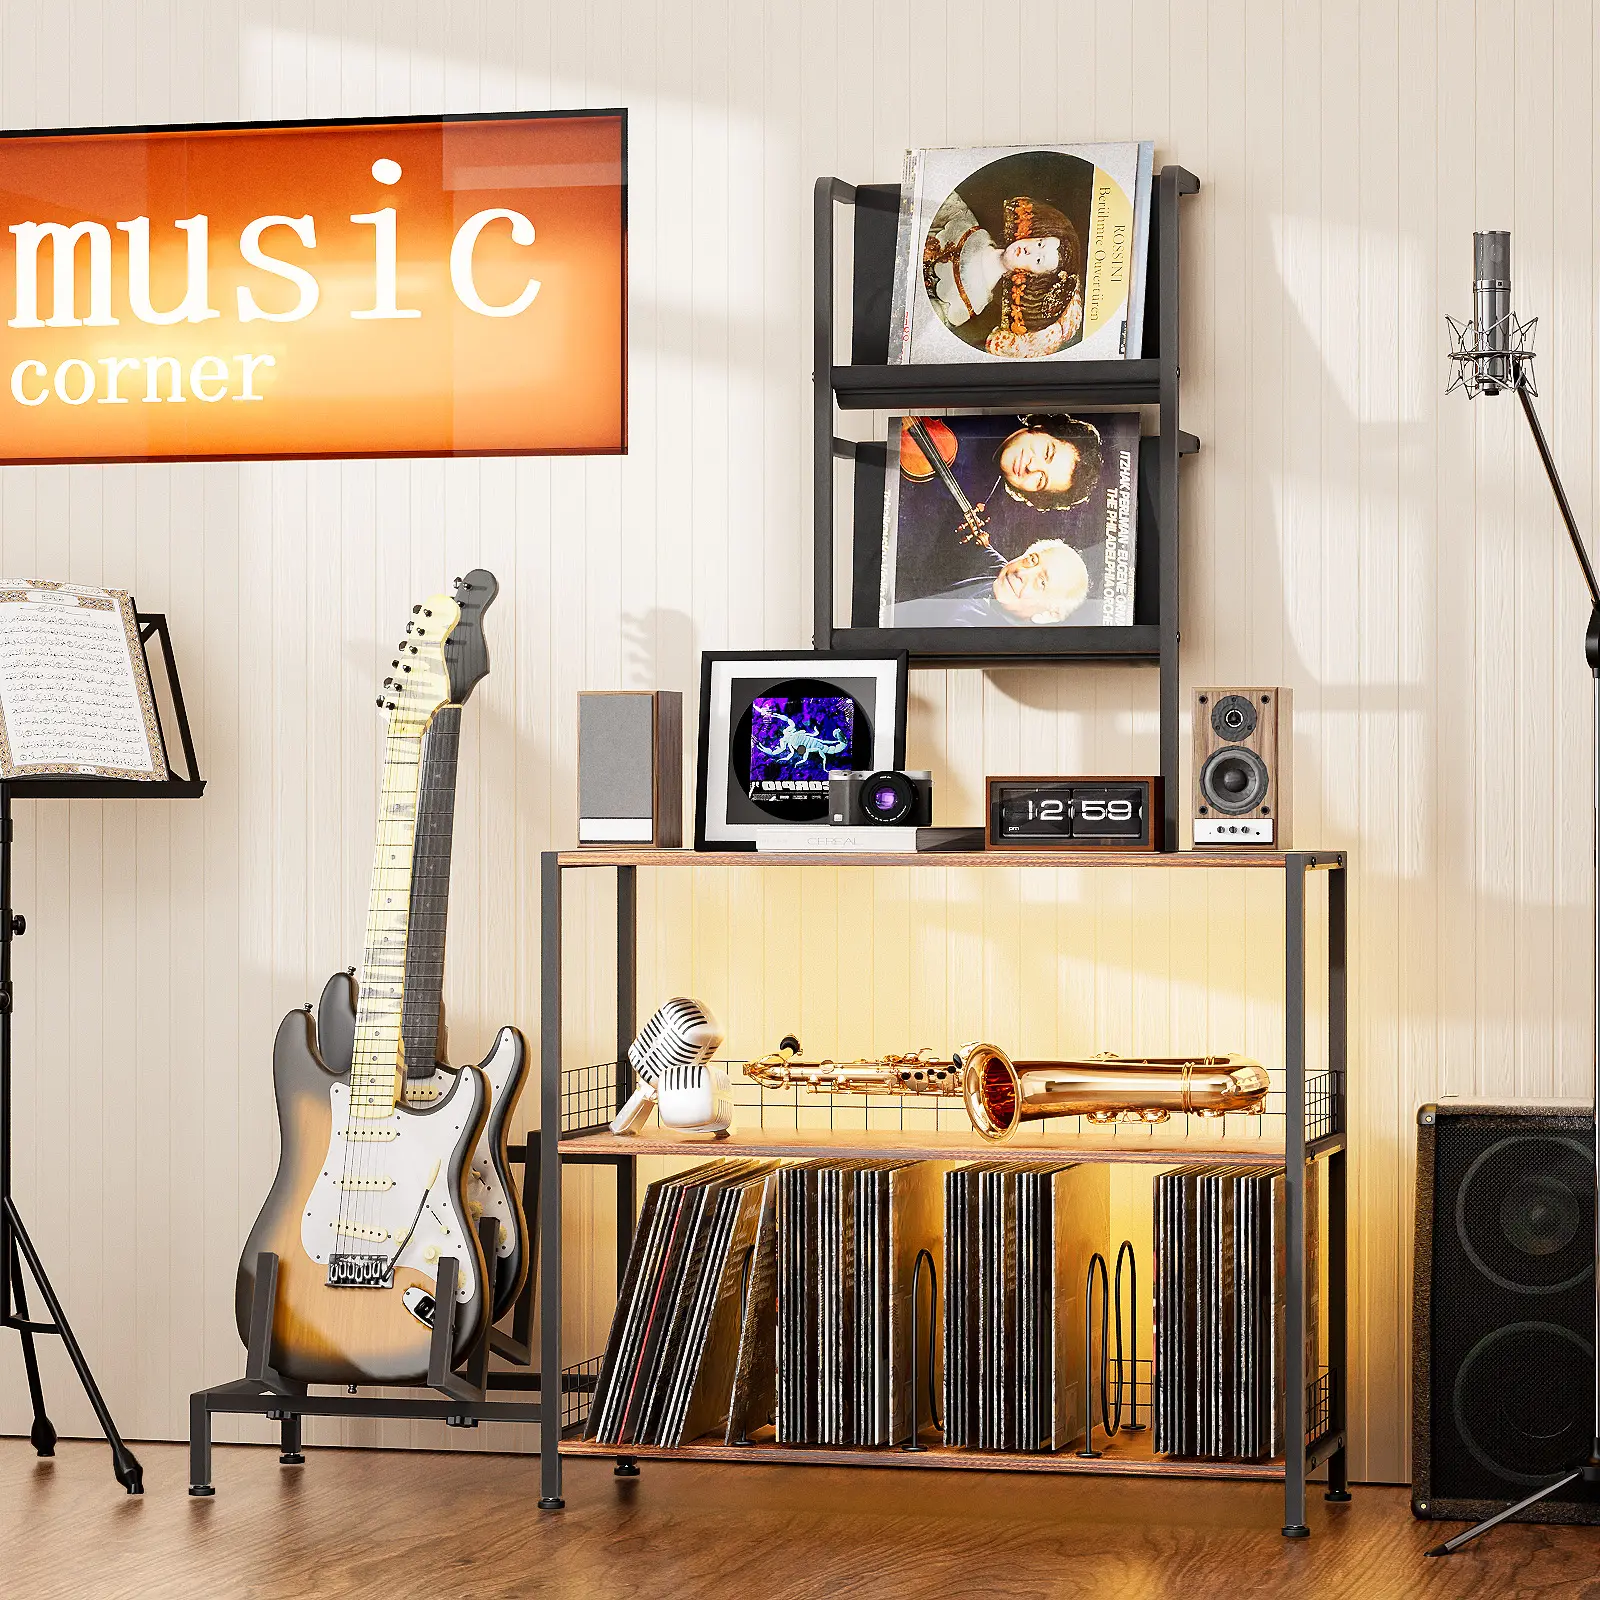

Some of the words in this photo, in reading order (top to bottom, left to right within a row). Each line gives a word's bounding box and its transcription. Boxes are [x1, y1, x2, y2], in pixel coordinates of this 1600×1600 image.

[8, 158, 542, 328] music
[1095, 186, 1111, 246] Berühmte
[1110, 224, 1126, 284] ROSSINI
[1089, 249, 1107, 321] Ouvertüren
[10, 353, 276, 406] corner
[1118, 450, 1131, 491] ITZHAK
[1106, 487, 1118, 510] THE
[1117, 490, 1130, 544] PERLMAN
[1104, 510, 1117, 587] PHILADELPHIA
[1116, 549, 1129, 594] EUGENE
[807, 837, 864, 846] CEREAL
